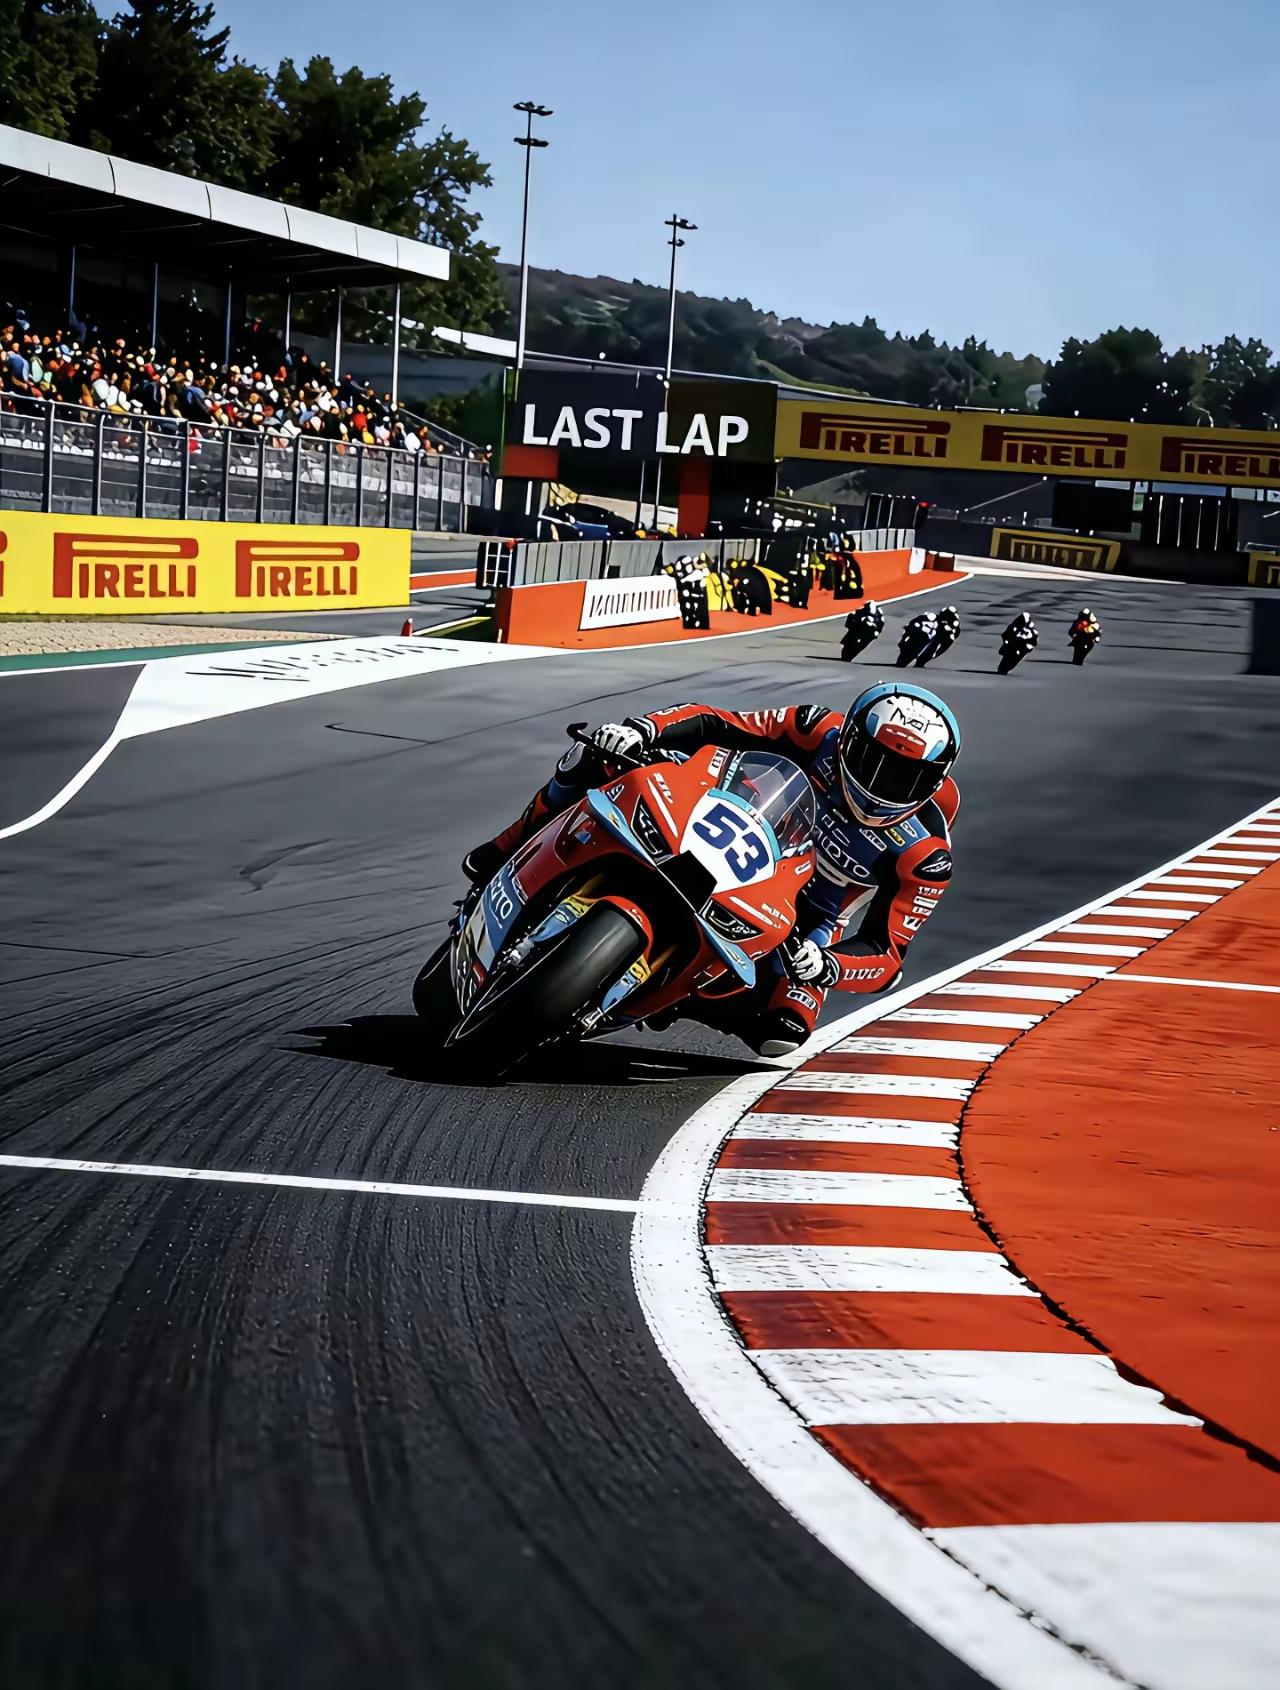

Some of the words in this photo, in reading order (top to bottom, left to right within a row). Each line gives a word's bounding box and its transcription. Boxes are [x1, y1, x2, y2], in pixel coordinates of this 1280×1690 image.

[523, 403, 643, 451] LAST
[656, 411, 749, 457] LAP
[799, 411, 951, 459] PIRELLI
[980, 424, 1128, 469] PIRELLI
[1160, 436, 1280, 480] PIRELL
[53, 532, 199, 598] PIRELLI
[235, 540, 360, 598] PIRELLI
[692, 803, 770, 882] 53
